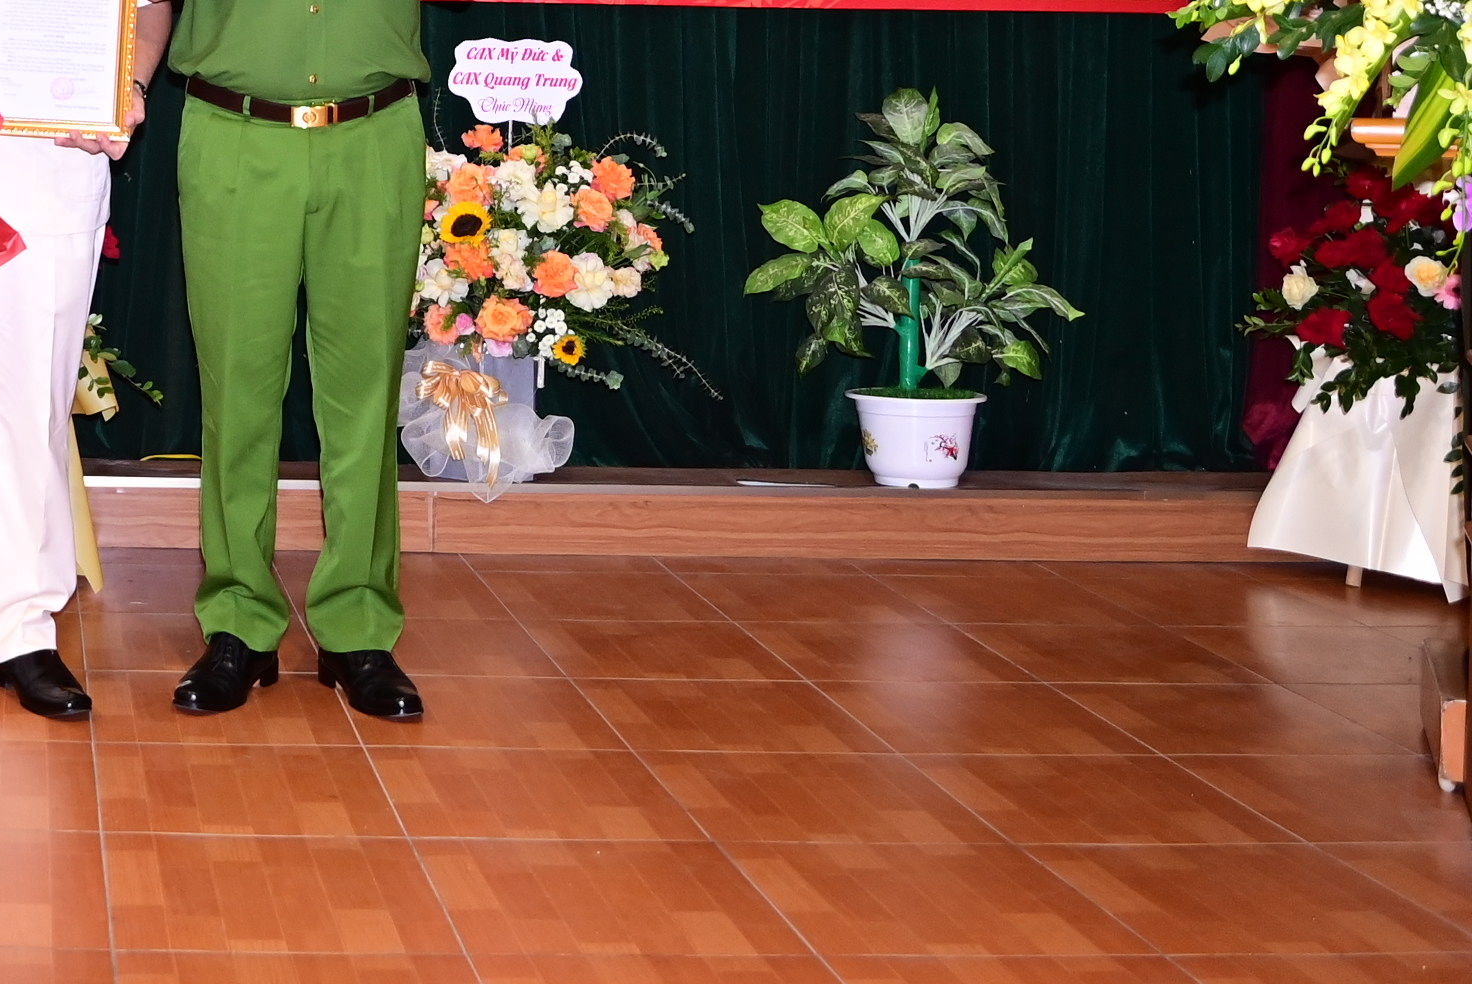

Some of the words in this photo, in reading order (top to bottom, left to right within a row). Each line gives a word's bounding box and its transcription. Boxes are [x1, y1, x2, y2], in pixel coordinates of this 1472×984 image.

[466, 46, 496, 61] CAX
[551, 48, 564, 63] &
[452, 71, 482, 86] CAX
[483, 72, 531, 90] Quang
[535, 73, 578, 91] Trung
